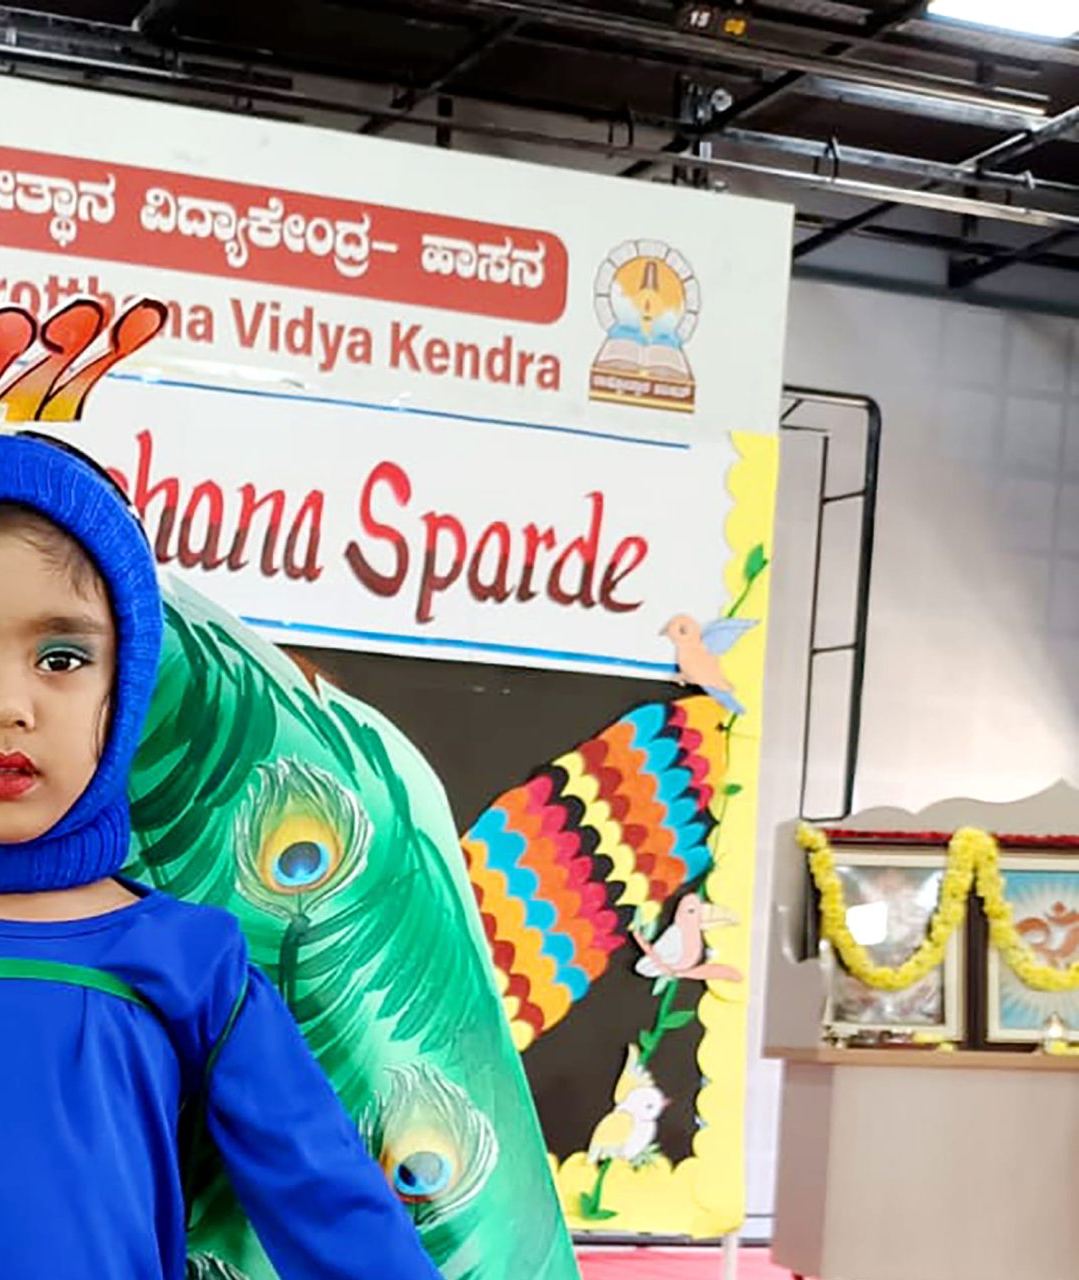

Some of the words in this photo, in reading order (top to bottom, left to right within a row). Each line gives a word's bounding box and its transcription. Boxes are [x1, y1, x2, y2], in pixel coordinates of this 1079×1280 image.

[421, 233, 546, 289] ಹಾಸನ
[231, 299, 373, 373] Vidya
[389, 322, 561, 391] Kendra
[344, 460, 650, 625] Sparde
